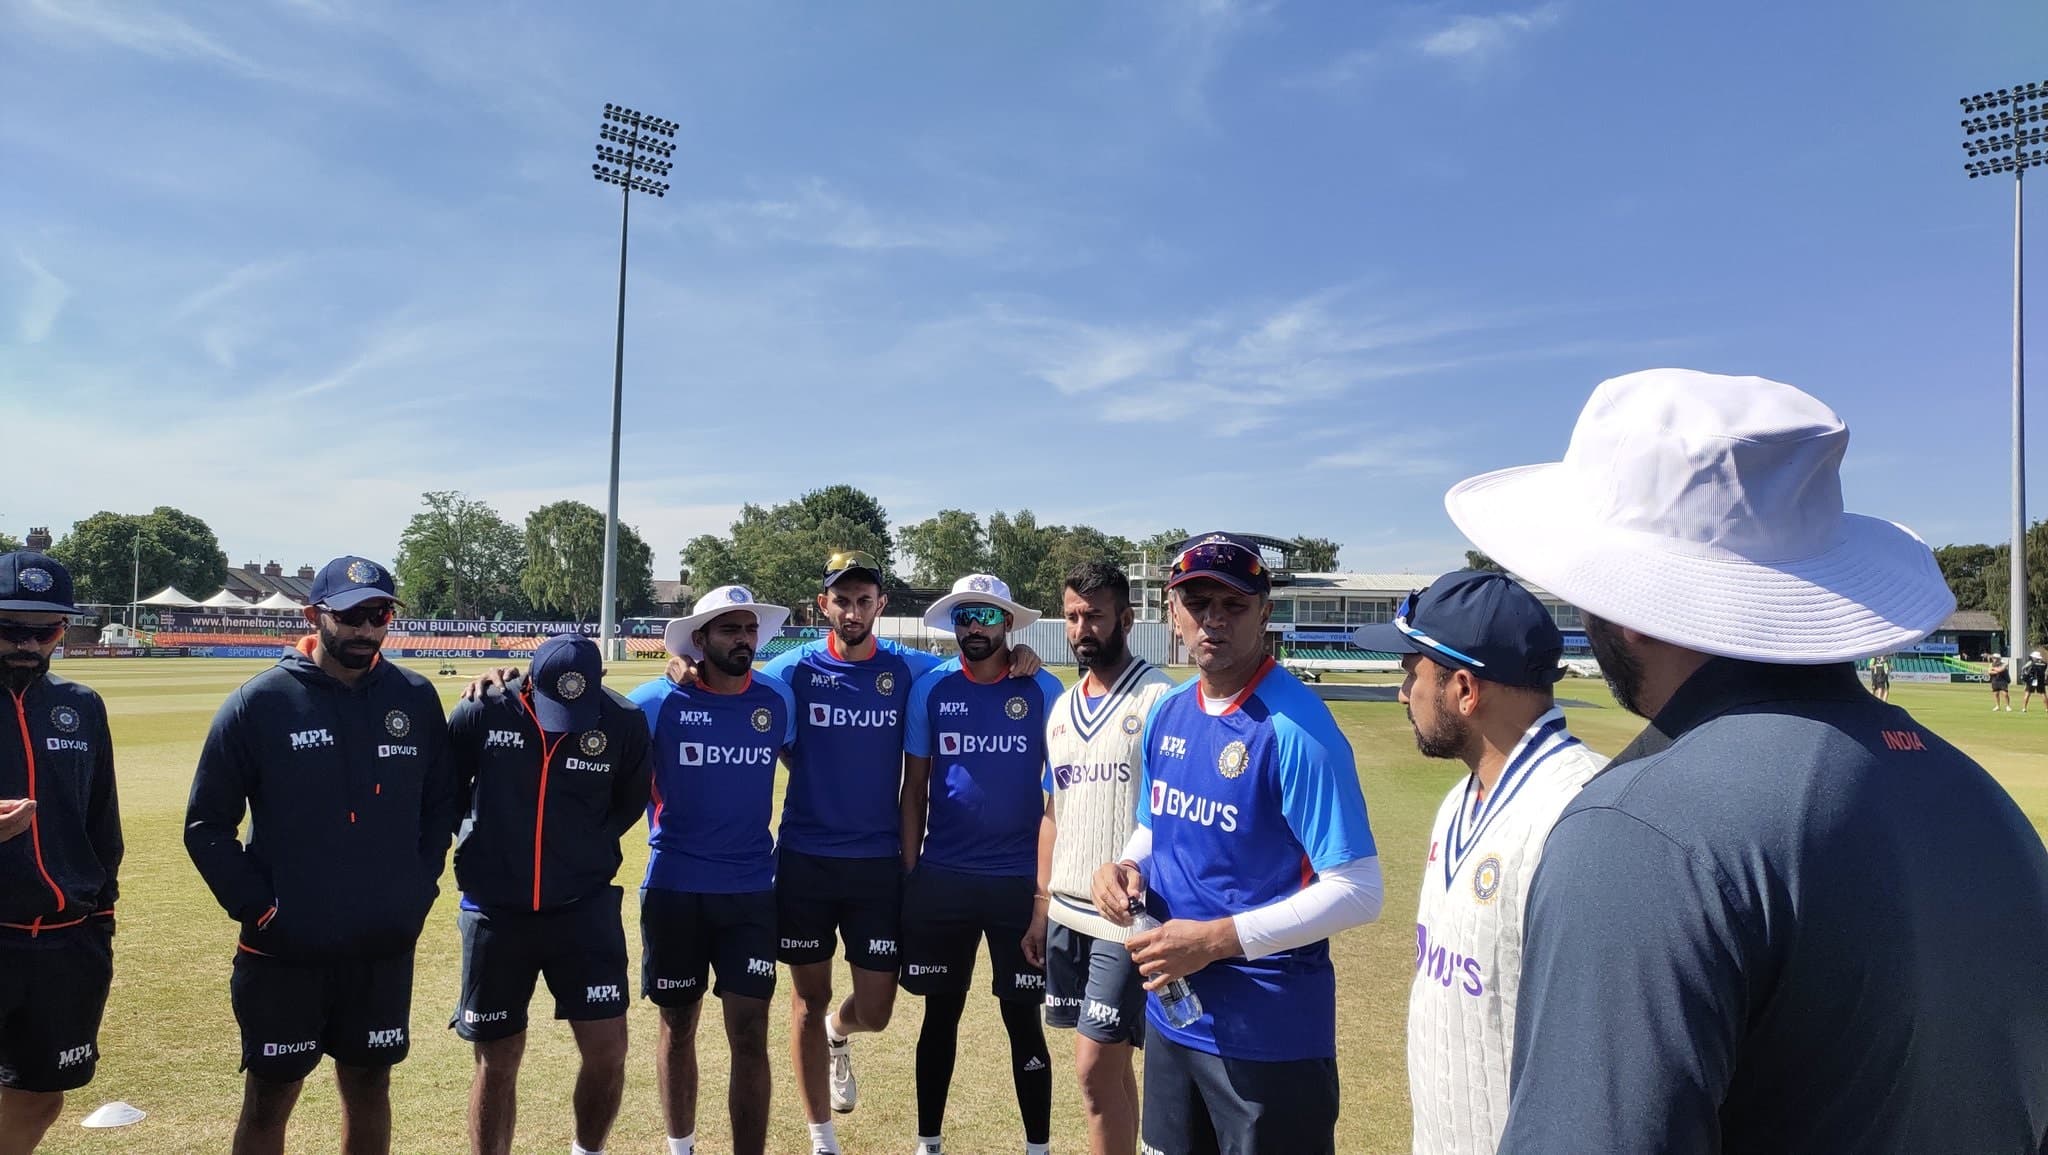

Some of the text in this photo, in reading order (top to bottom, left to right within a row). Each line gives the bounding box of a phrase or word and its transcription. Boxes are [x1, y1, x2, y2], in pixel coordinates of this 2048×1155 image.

[192, 617, 310, 629] www.themelton.co.uk
[387, 620, 622, 634] ELTON BUILDING SOCIETY FAMILY STAD
[415, 649, 472, 657] OFFICECARE
[636, 651, 666, 659] PHIZZ
[940, 702, 969, 713] MPL
[680, 711, 712, 722] MPL
[833, 708, 897, 727] BYJU'S
[290, 729, 333, 746] MPL
[487, 730, 524, 746] MPL
[963, 735, 1027, 753] BYJU'S
[1881, 730, 1928, 751] INDIA
[707, 746, 772, 764] BYJU'S
[579, 760, 611, 772] BYJU'S
[1071, 763, 1131, 784] BYJU'S
[1166, 788, 1239, 832] BYJU'S
[868, 939, 898, 952] MPL
[1015, 973, 1046, 986] MPL
[587, 985, 620, 999] MPL
[473, 1010, 508, 1022] BYJU'S
[368, 1028, 404, 1044] MPL
[59, 1043, 93, 1065] MPL
[278, 1040, 317, 1055] BYJU'S
